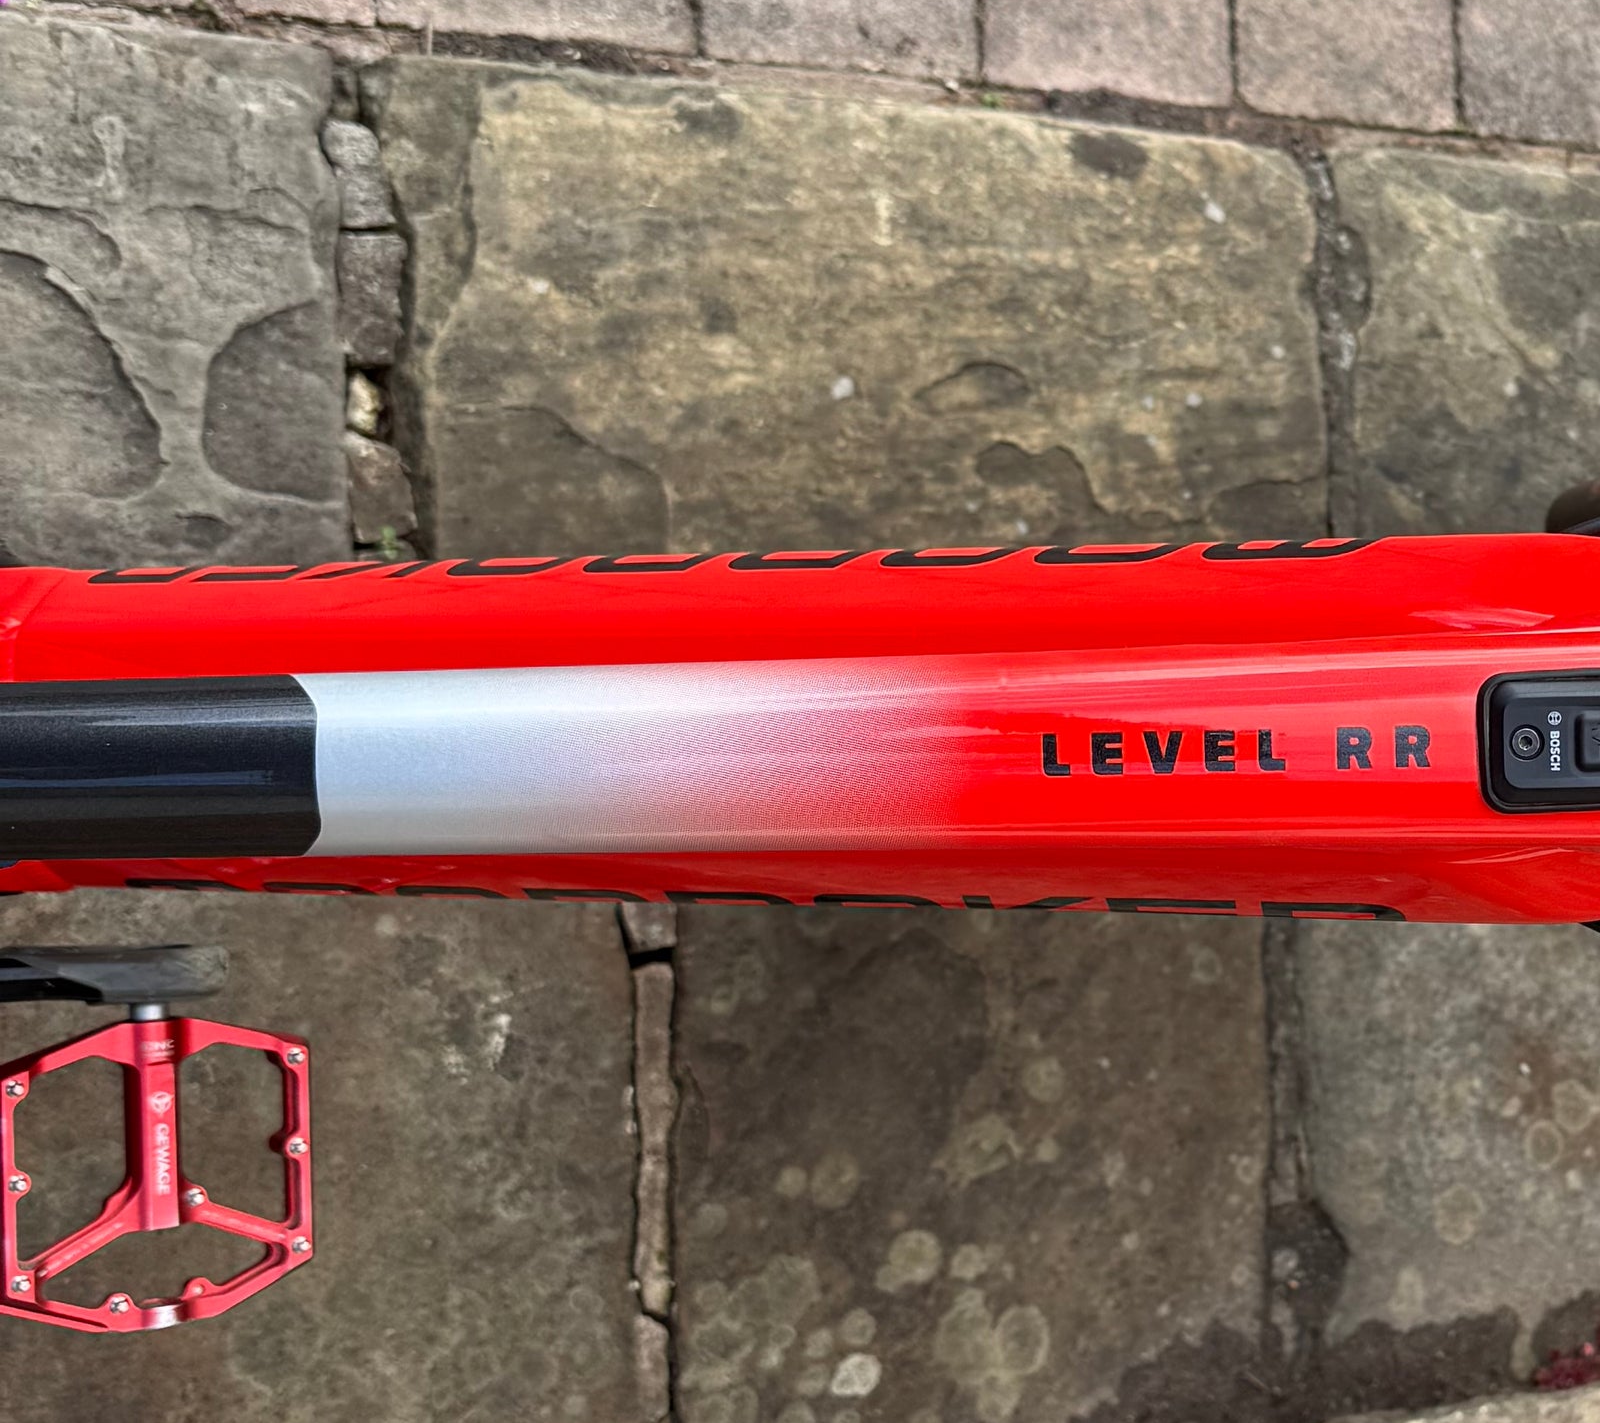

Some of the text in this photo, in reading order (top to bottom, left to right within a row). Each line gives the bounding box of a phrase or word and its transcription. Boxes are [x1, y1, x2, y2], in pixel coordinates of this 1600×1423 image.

[1041, 725, 1432, 777] LEVEL RR
[1550, 730, 1561, 772] BOSCH
[155, 1123, 171, 1196] GEWAGE
